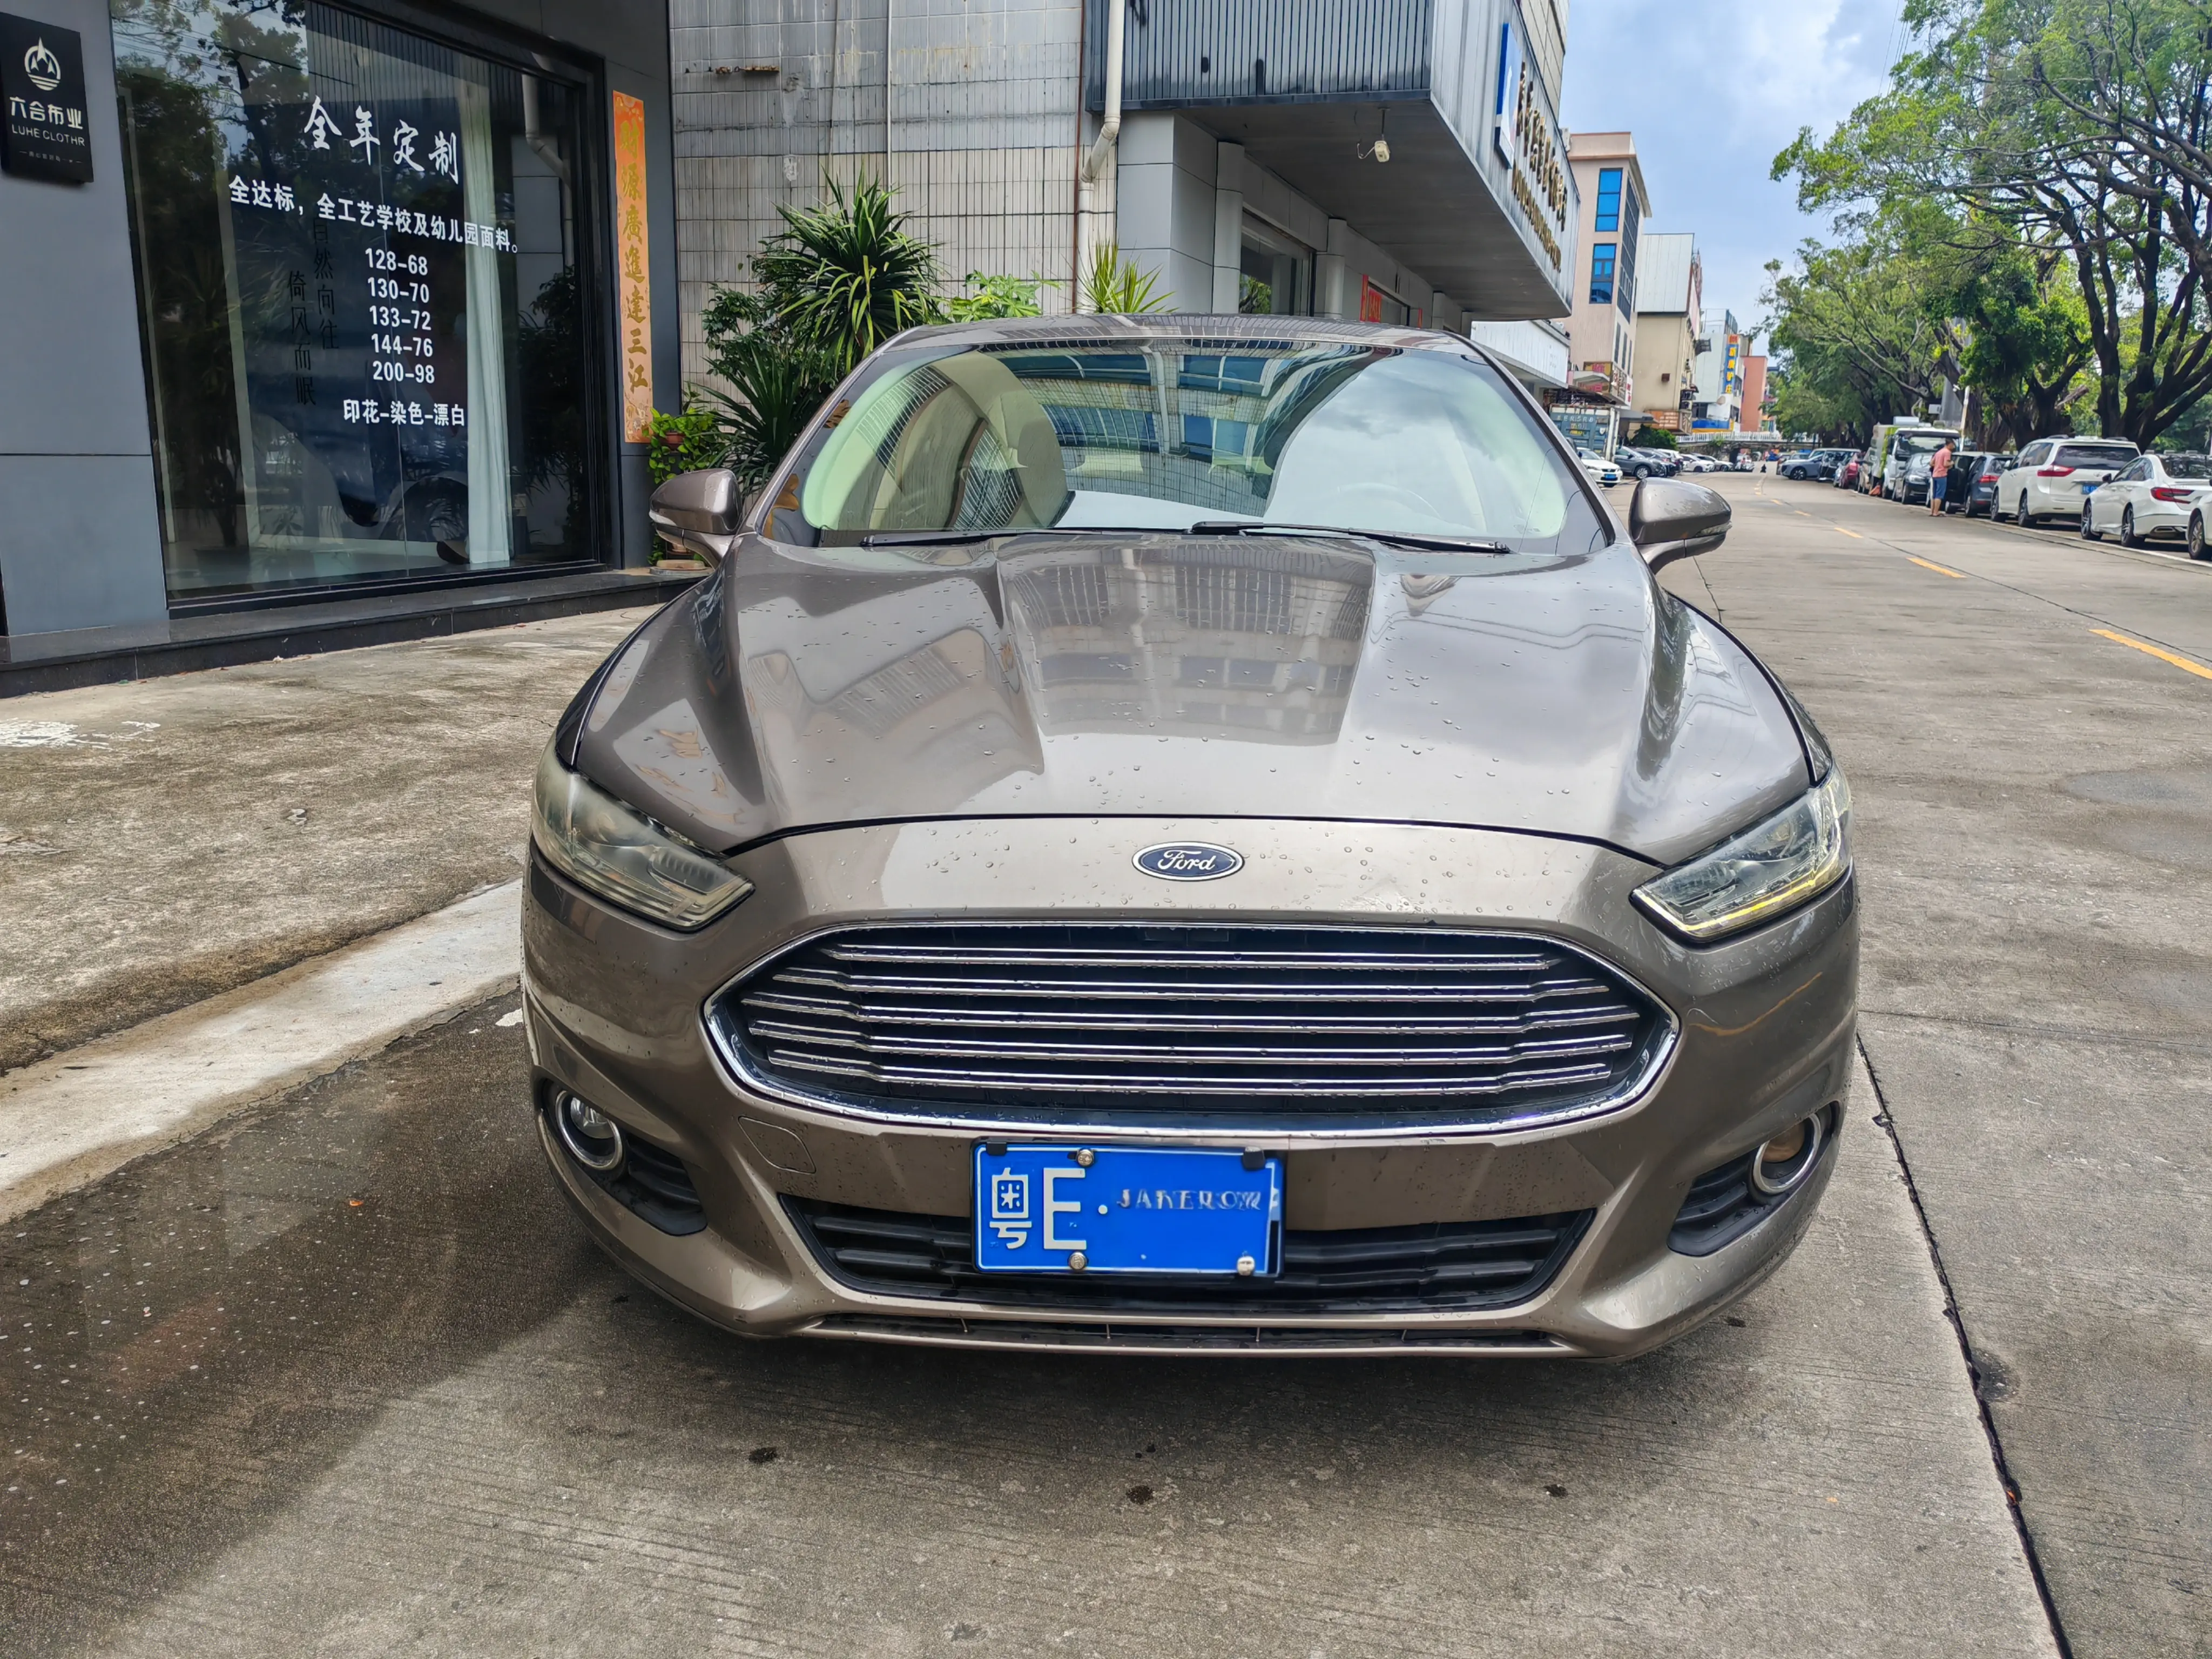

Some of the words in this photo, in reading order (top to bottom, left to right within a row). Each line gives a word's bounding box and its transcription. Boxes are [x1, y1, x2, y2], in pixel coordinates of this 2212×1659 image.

[9, 96, 83, 130] 六合布业
[11, 124, 41, 138] LUHE
[42, 130, 85, 147] CLOTHR
[304, 95, 459, 185] 全年定制
[365, 248, 428, 276] 128-68
[367, 277, 430, 304] 130-70
[369, 305, 431, 331] 133-72
[371, 333, 433, 357] 144-76
[373, 360, 435, 384] 200-98
[1157, 849, 1217, 870] Ford
